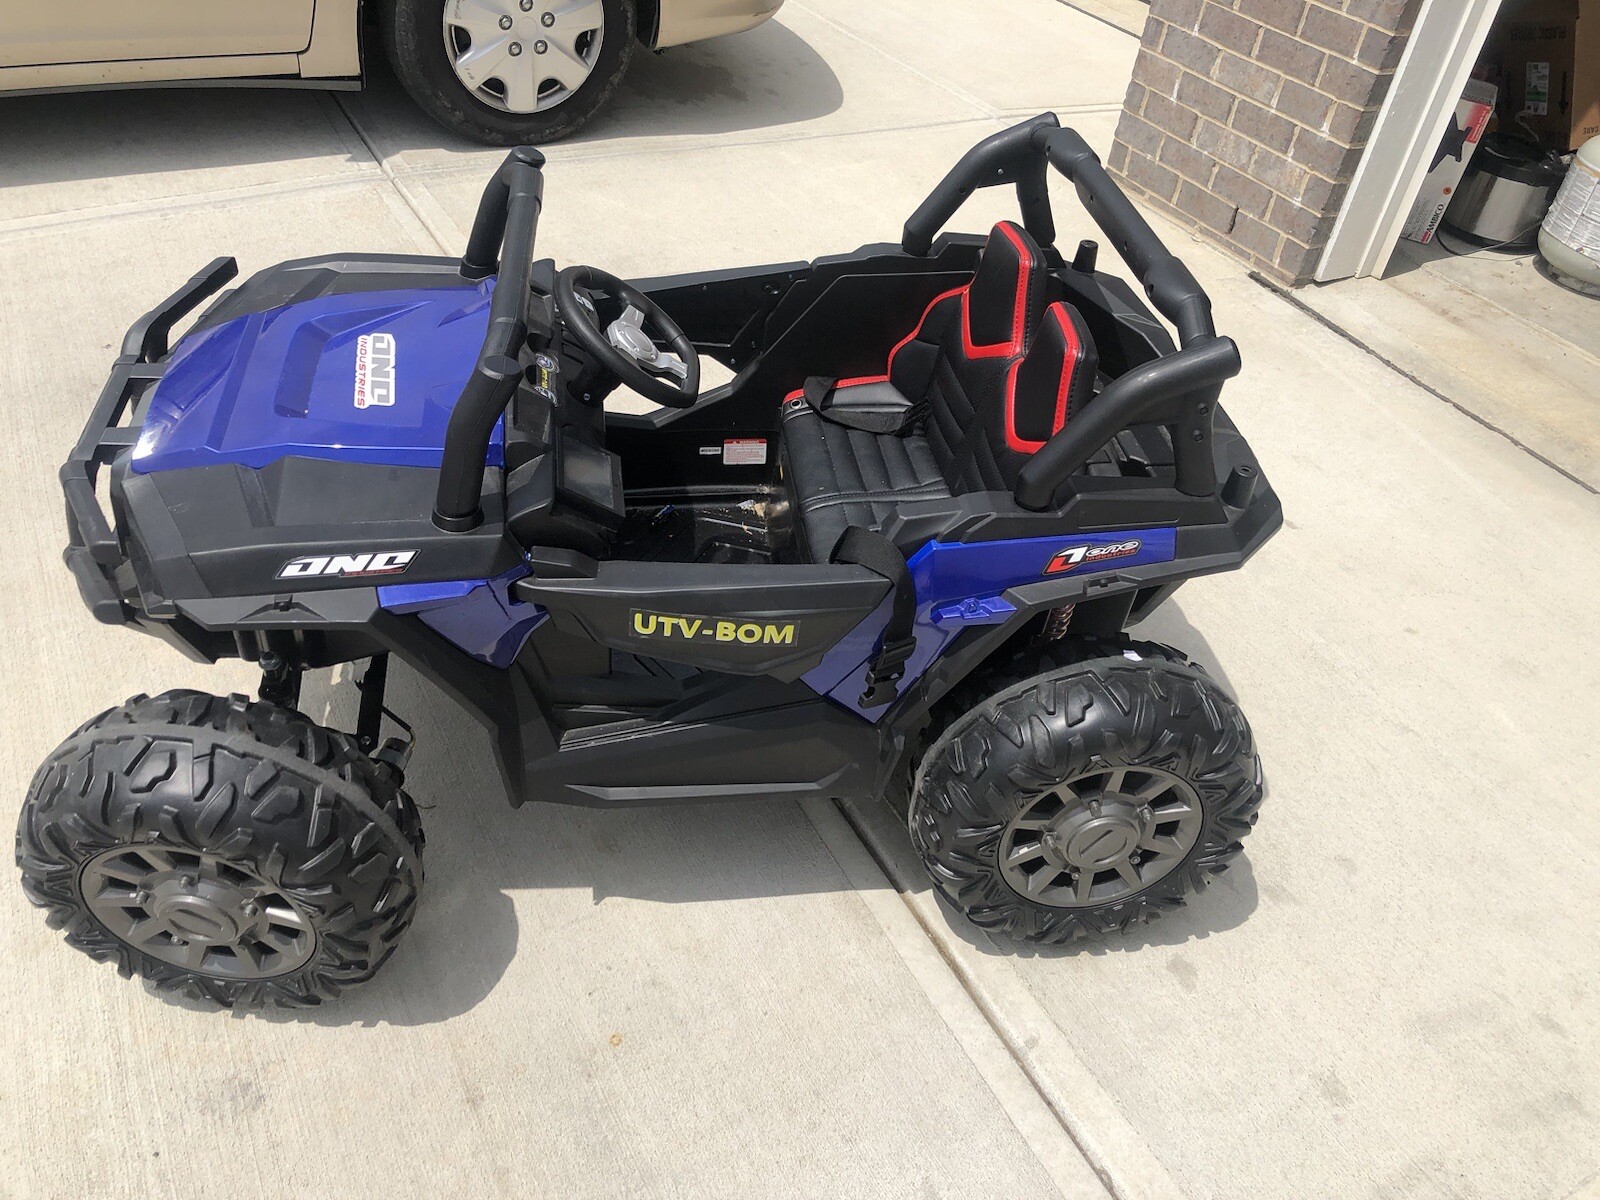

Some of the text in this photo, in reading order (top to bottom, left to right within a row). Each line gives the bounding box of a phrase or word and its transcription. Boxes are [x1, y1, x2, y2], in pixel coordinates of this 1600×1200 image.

[1427, 203, 1444, 233] AMBICO
[357, 337, 367, 407] INDUSTRIES
[633, 612, 795, 645] UTV-BOM
